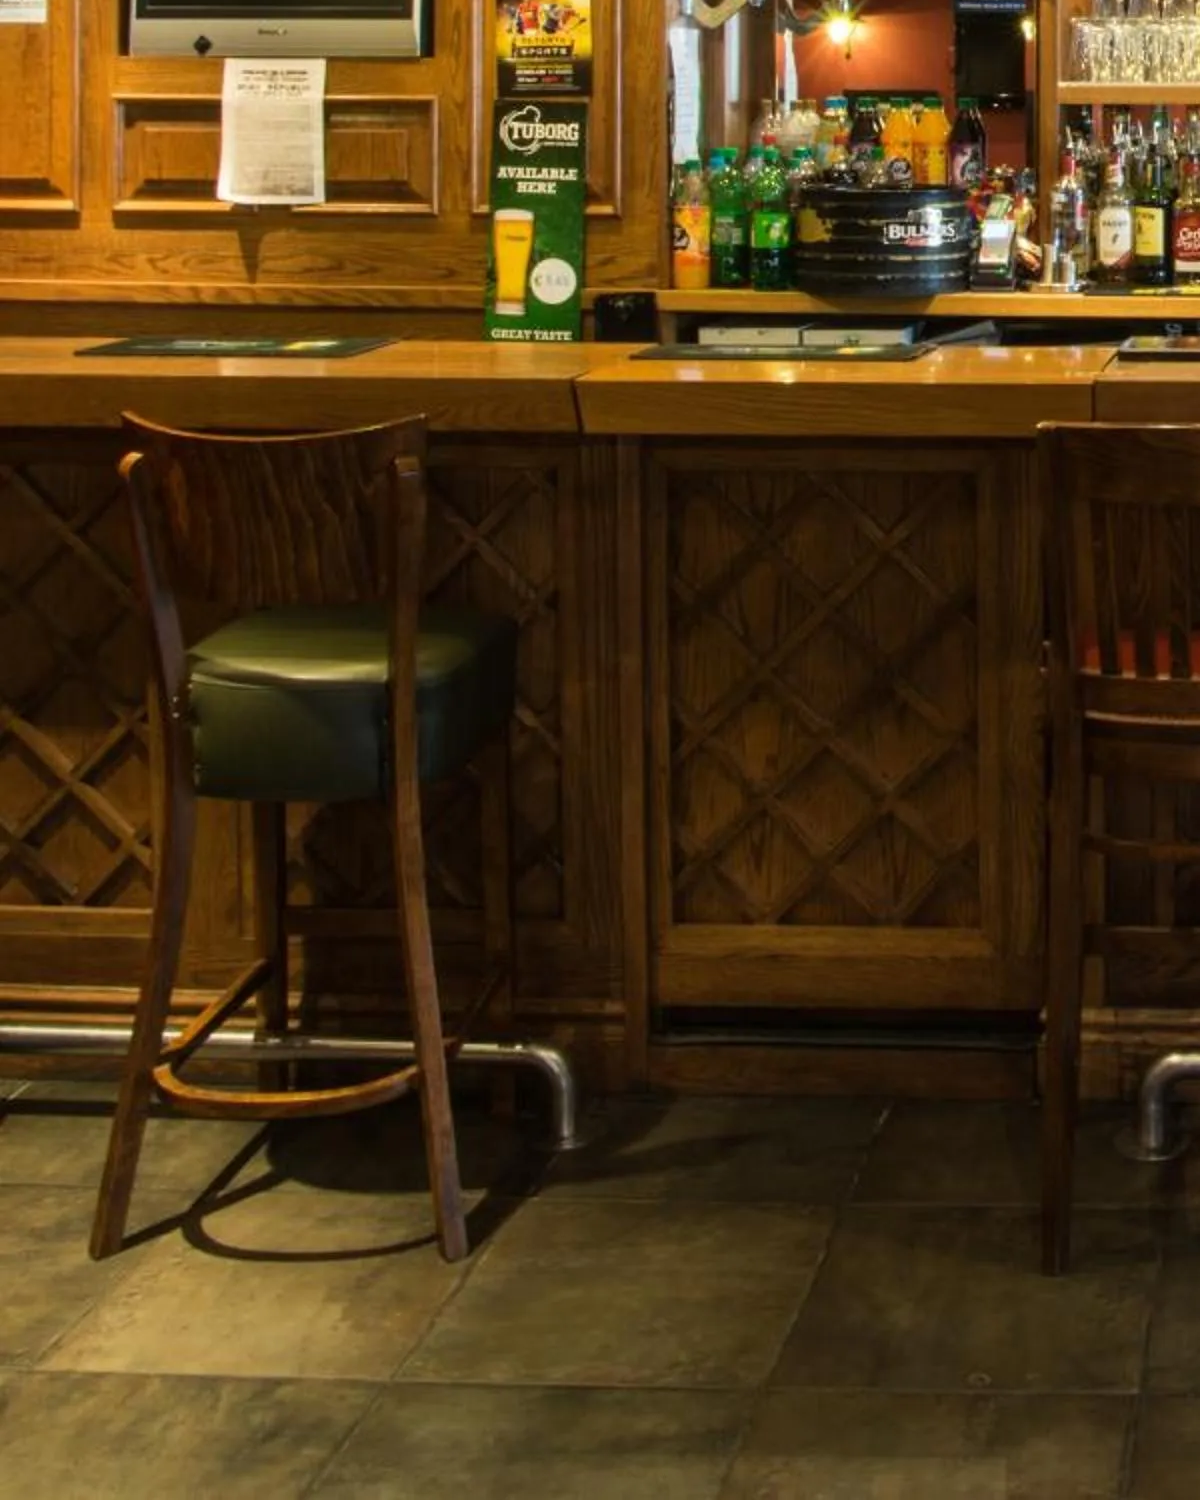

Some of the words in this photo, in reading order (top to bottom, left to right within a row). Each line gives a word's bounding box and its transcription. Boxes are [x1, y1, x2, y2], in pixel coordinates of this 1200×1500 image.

[510, 122, 580, 142] TUBORG
[497, 166, 578, 181] AVAILABLE
[516, 181, 557, 195] HERE
[491, 328, 531, 342] GREAT
[533, 329, 573, 342] TASTE
